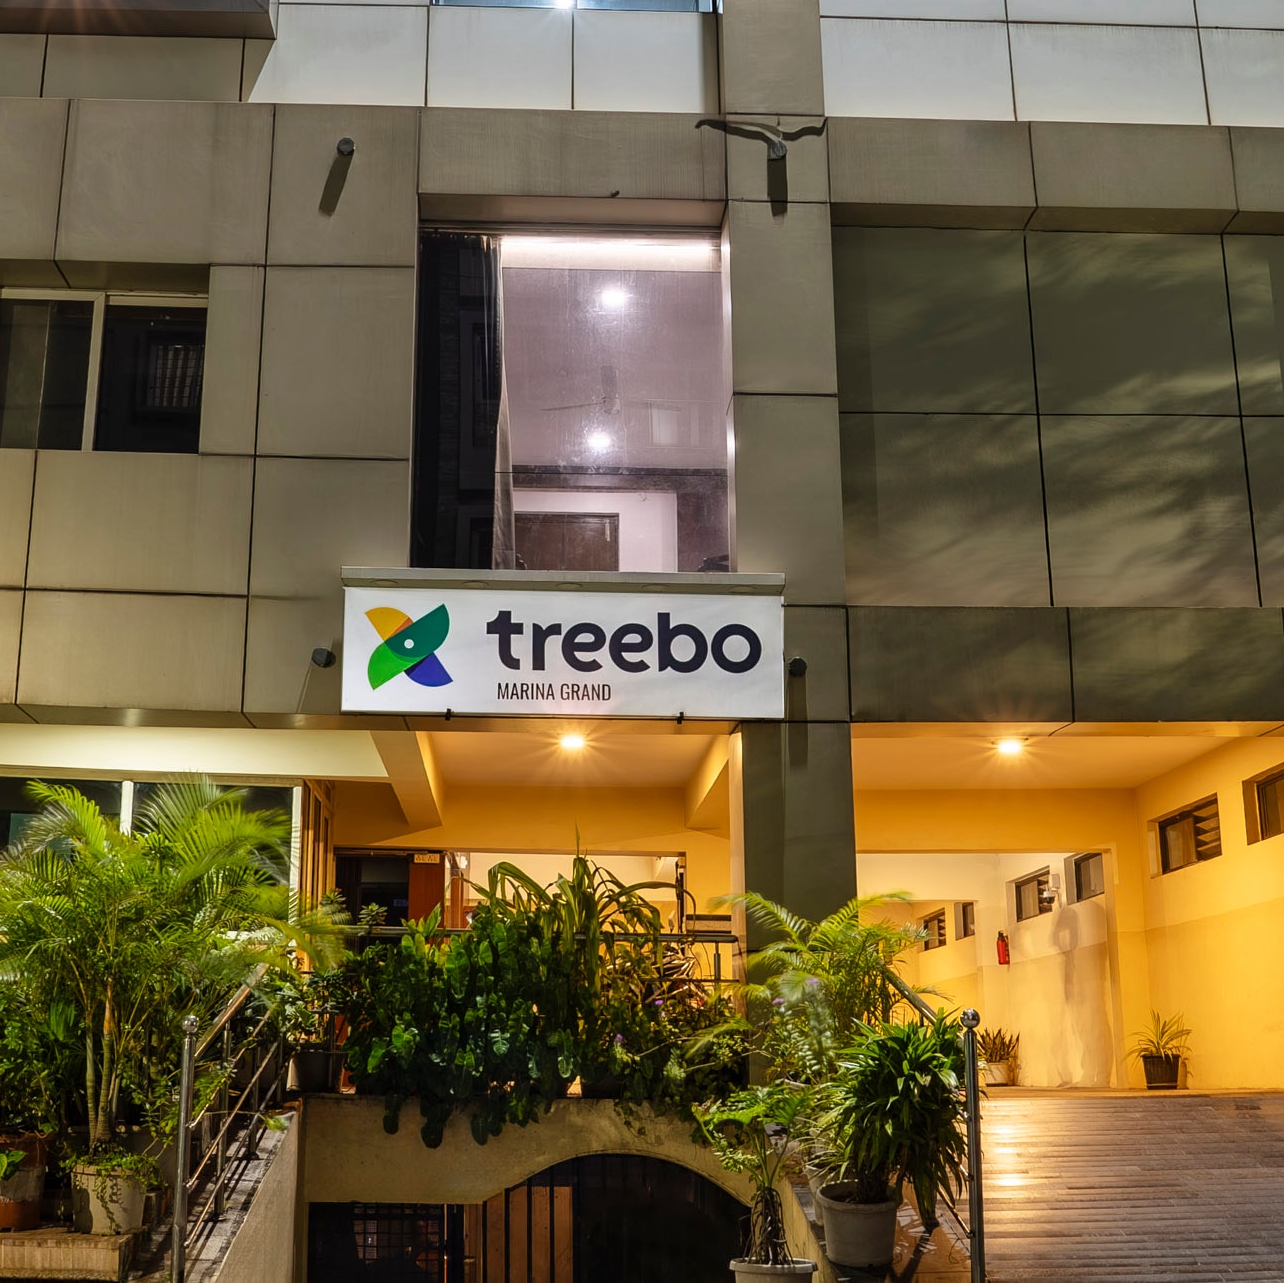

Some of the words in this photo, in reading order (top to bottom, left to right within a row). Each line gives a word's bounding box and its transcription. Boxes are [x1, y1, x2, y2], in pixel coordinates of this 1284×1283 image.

[486, 610, 762, 674] treebo
[497, 682, 555, 700] MARINA
[560, 683, 611, 701] GRAND
